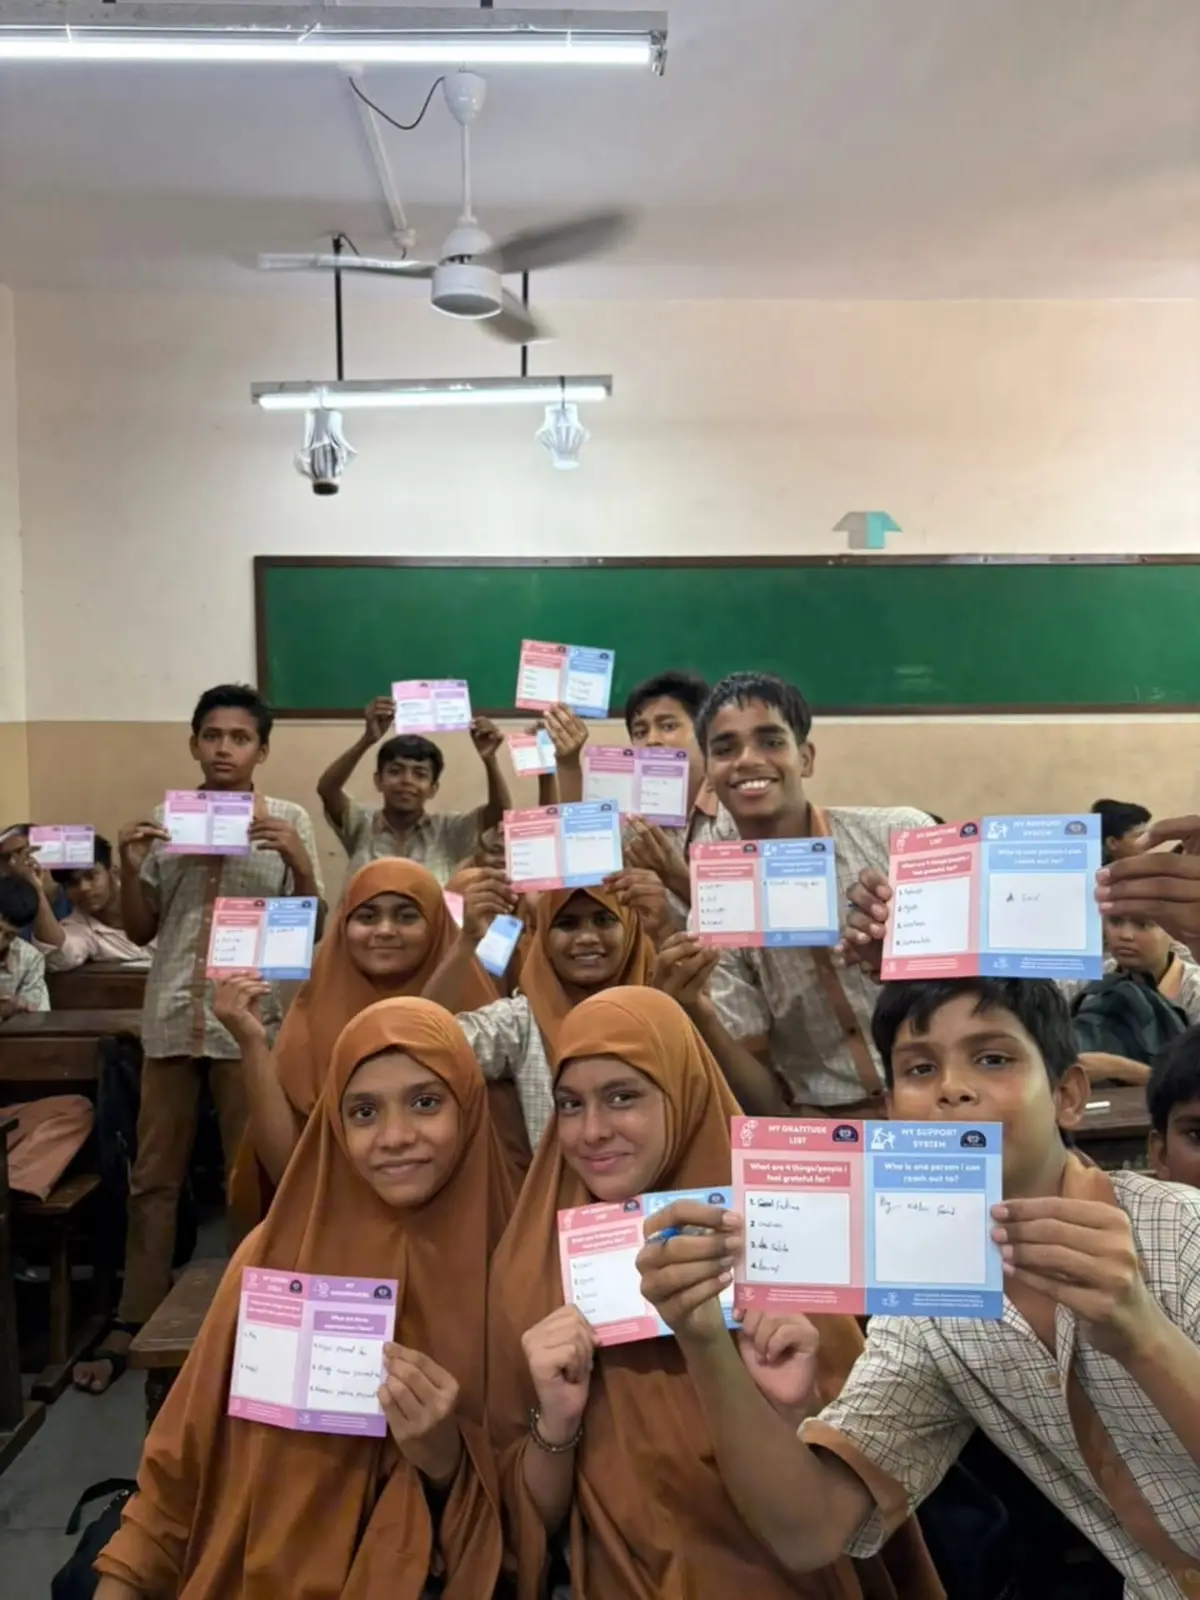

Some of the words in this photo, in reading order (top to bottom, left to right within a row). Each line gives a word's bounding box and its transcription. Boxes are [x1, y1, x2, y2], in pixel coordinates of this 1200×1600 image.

[768, 1125, 780, 1133] MY
[782, 1125, 827, 1135] GRATITUDE
[902, 1128, 915, 1136] MY
[916, 1128, 957, 1136] SUPPORT
[789, 1137, 807, 1145] LIST
[913, 1140, 947, 1148] SYSTEM
[750, 1163, 770, 1171] What
[884, 1162, 903, 1171] Who
[930, 1164, 959, 1172] person
[783, 1175, 813, 1183] grateful
[944, 1175, 959, 1183] to?
